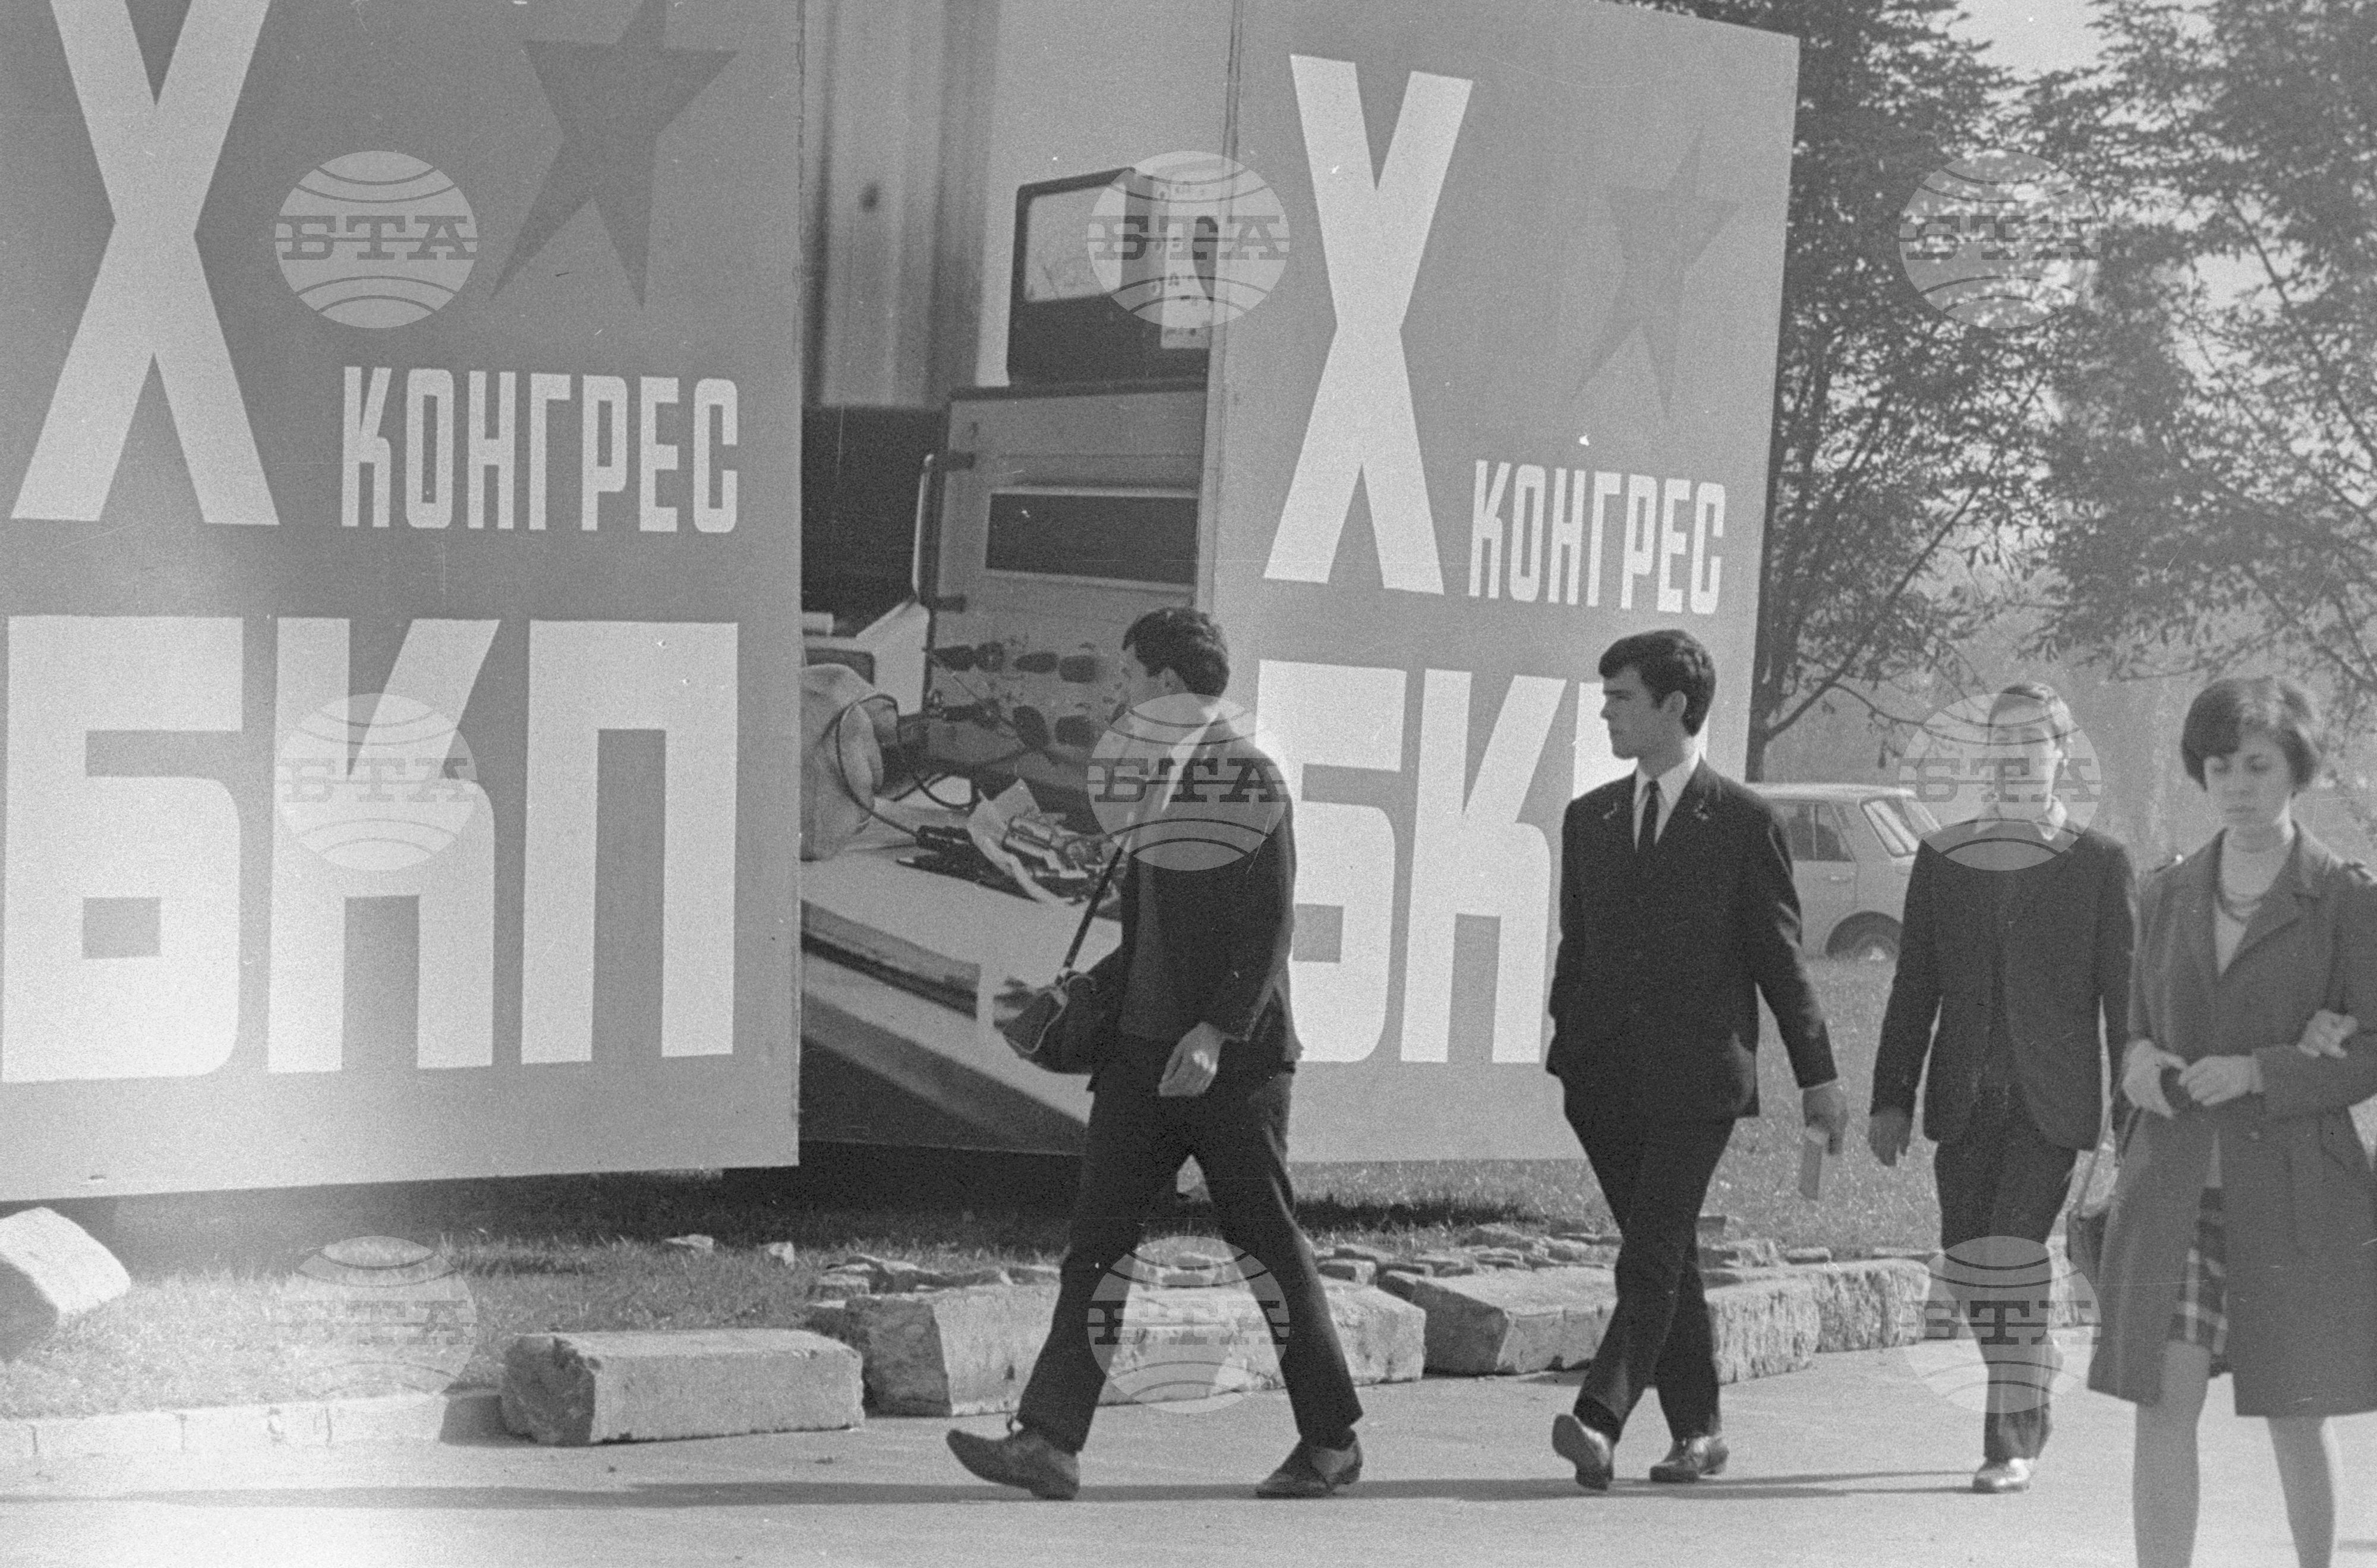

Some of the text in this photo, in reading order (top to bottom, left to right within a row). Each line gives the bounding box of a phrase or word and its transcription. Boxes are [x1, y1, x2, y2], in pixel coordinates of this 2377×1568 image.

[342, 366, 738, 533] КОНГРЕС
[1468, 459, 1726, 614] КОНГРЕС
[2, 614, 738, 1083] БКП
[1255, 659, 1708, 1064] БК
